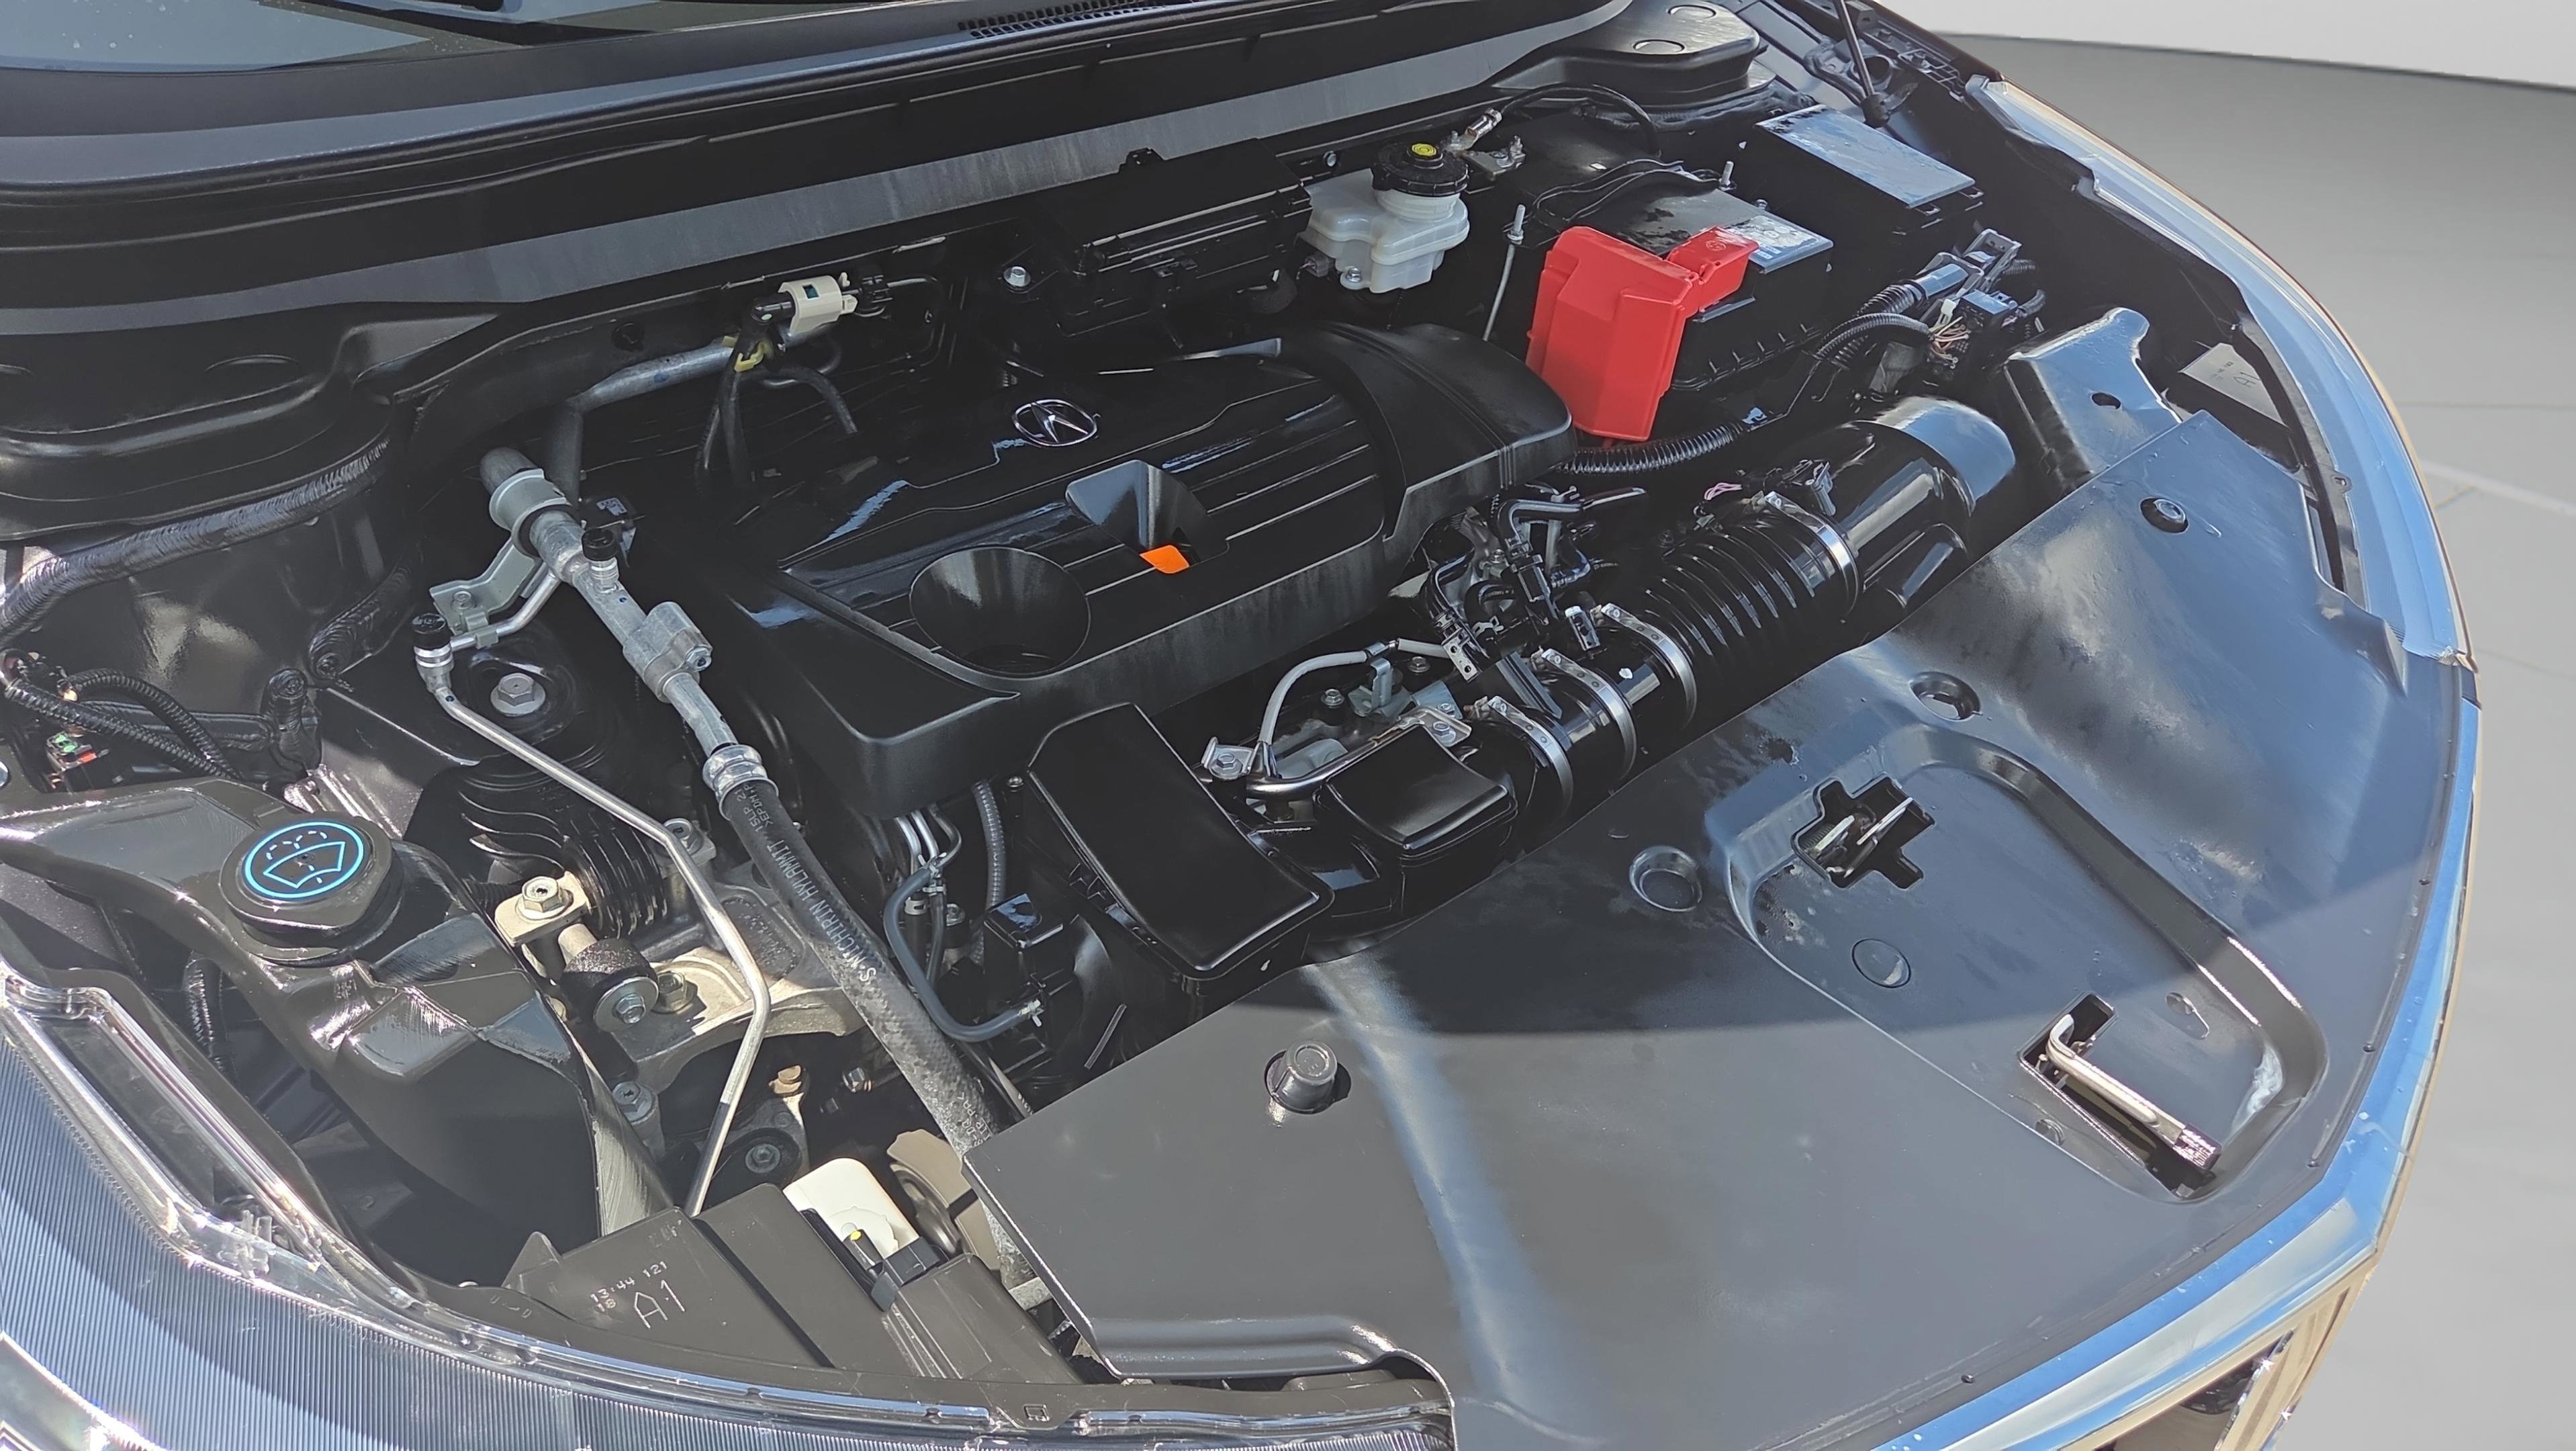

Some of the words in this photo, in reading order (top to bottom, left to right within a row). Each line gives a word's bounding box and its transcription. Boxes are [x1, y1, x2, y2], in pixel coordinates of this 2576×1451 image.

[743, 807, 764, 832] 15LP
[767, 840, 819, 901] HYLAMMIT
[591, 1277, 635, 1303] 13:44
[643, 1261, 668, 1277] 121
[634, 1279, 685, 1329] A1
